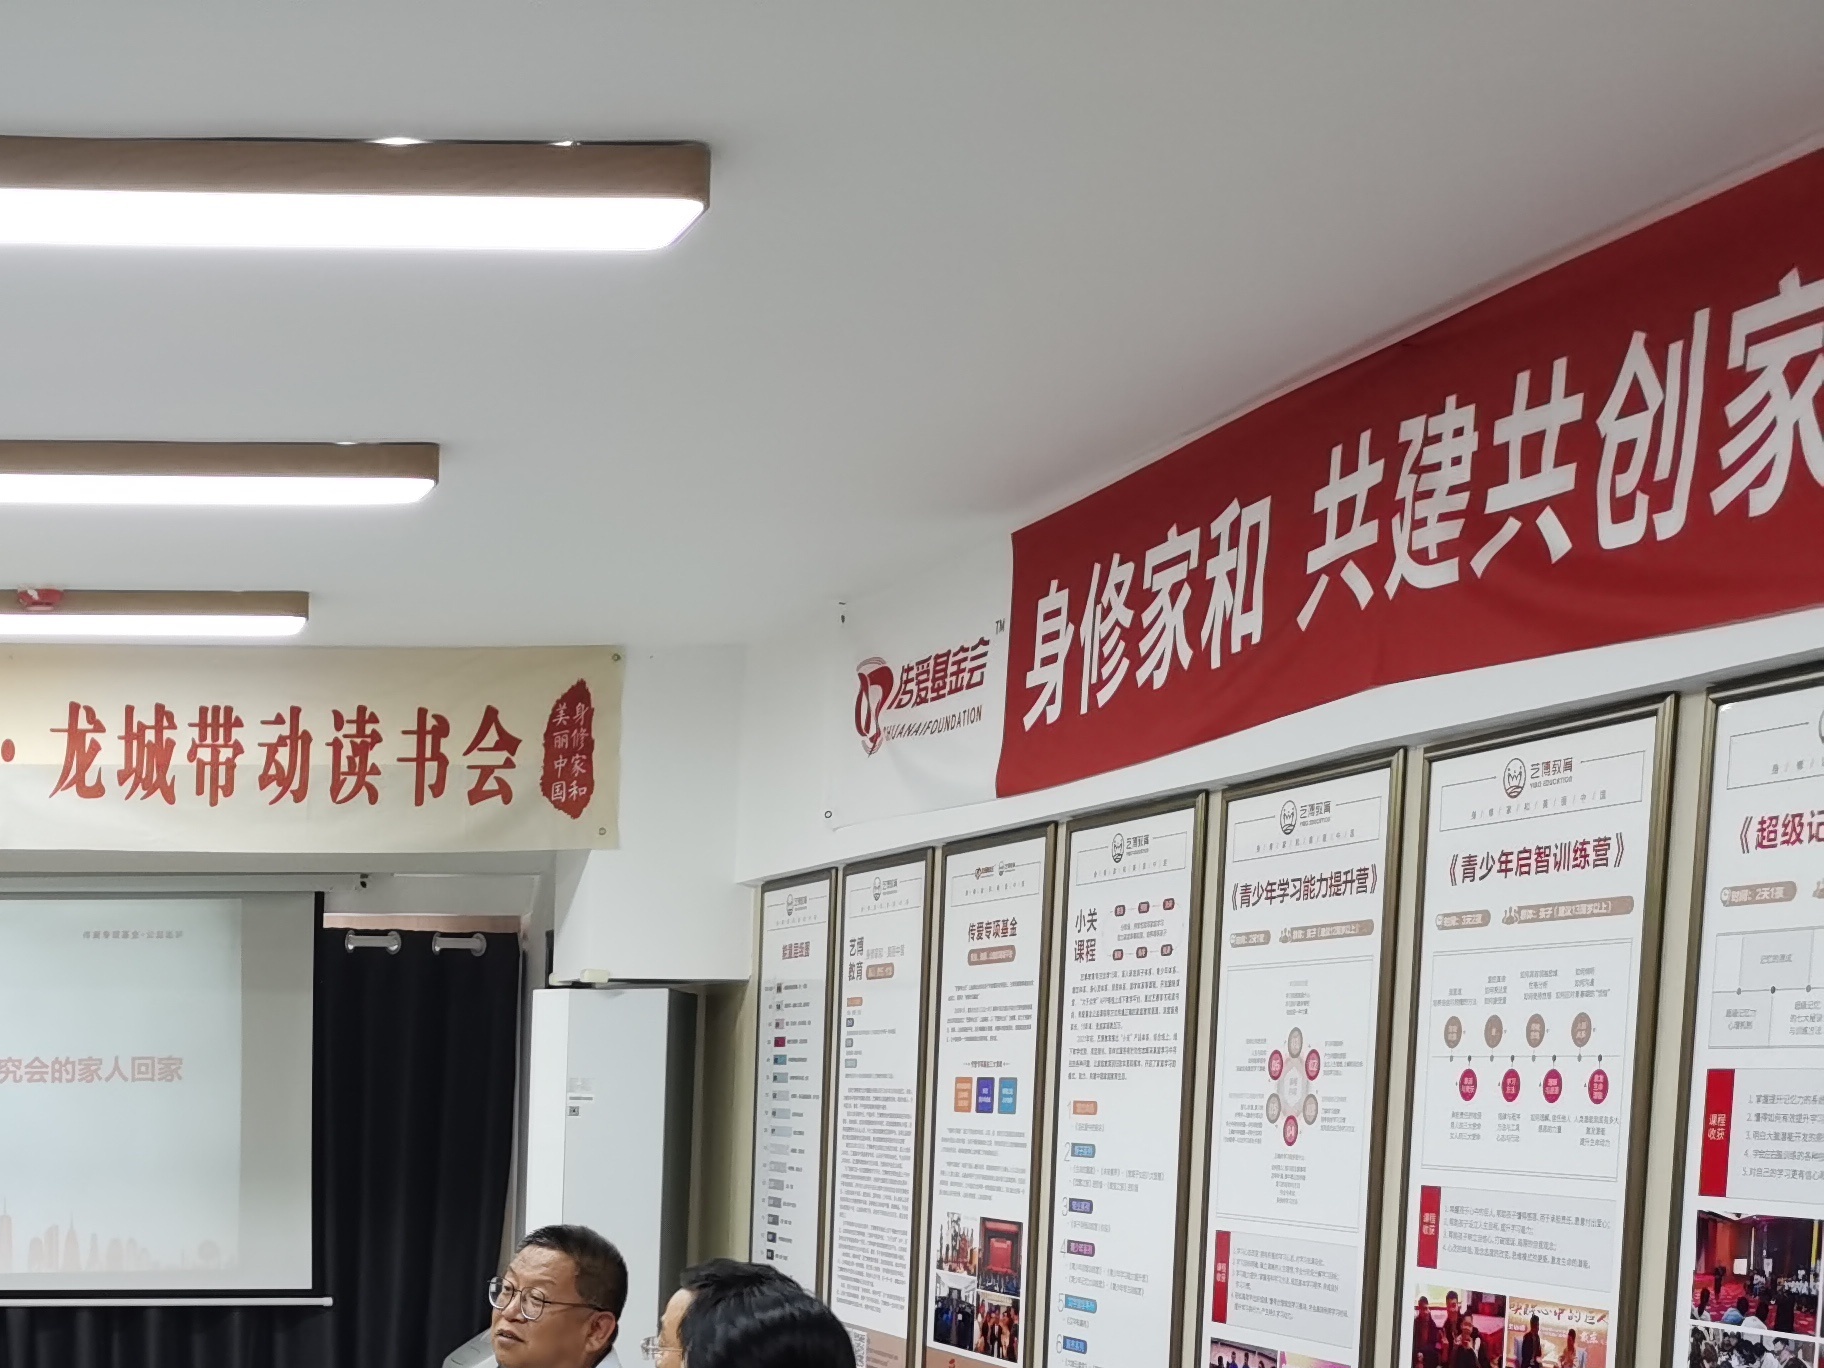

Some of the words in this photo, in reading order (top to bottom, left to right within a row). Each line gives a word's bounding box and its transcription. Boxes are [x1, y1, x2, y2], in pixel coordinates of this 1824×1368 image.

[1022, 494, 1272, 731] 身修家和
[1296, 266, 1824, 632] 共建共创家
[887, 636, 990, 710] 传爱基金会
[551, 702, 570, 803] 美丽中国
[570, 702, 589, 799] 身修家和
[1531, 757, 1574, 779] 艺博教育
[1231, 863, 1378, 911] 《青少年学习能力提升营》
[1449, 832, 1625, 887] 《青少年启智训练营》
[1074, 938, 1097, 964] 课程
